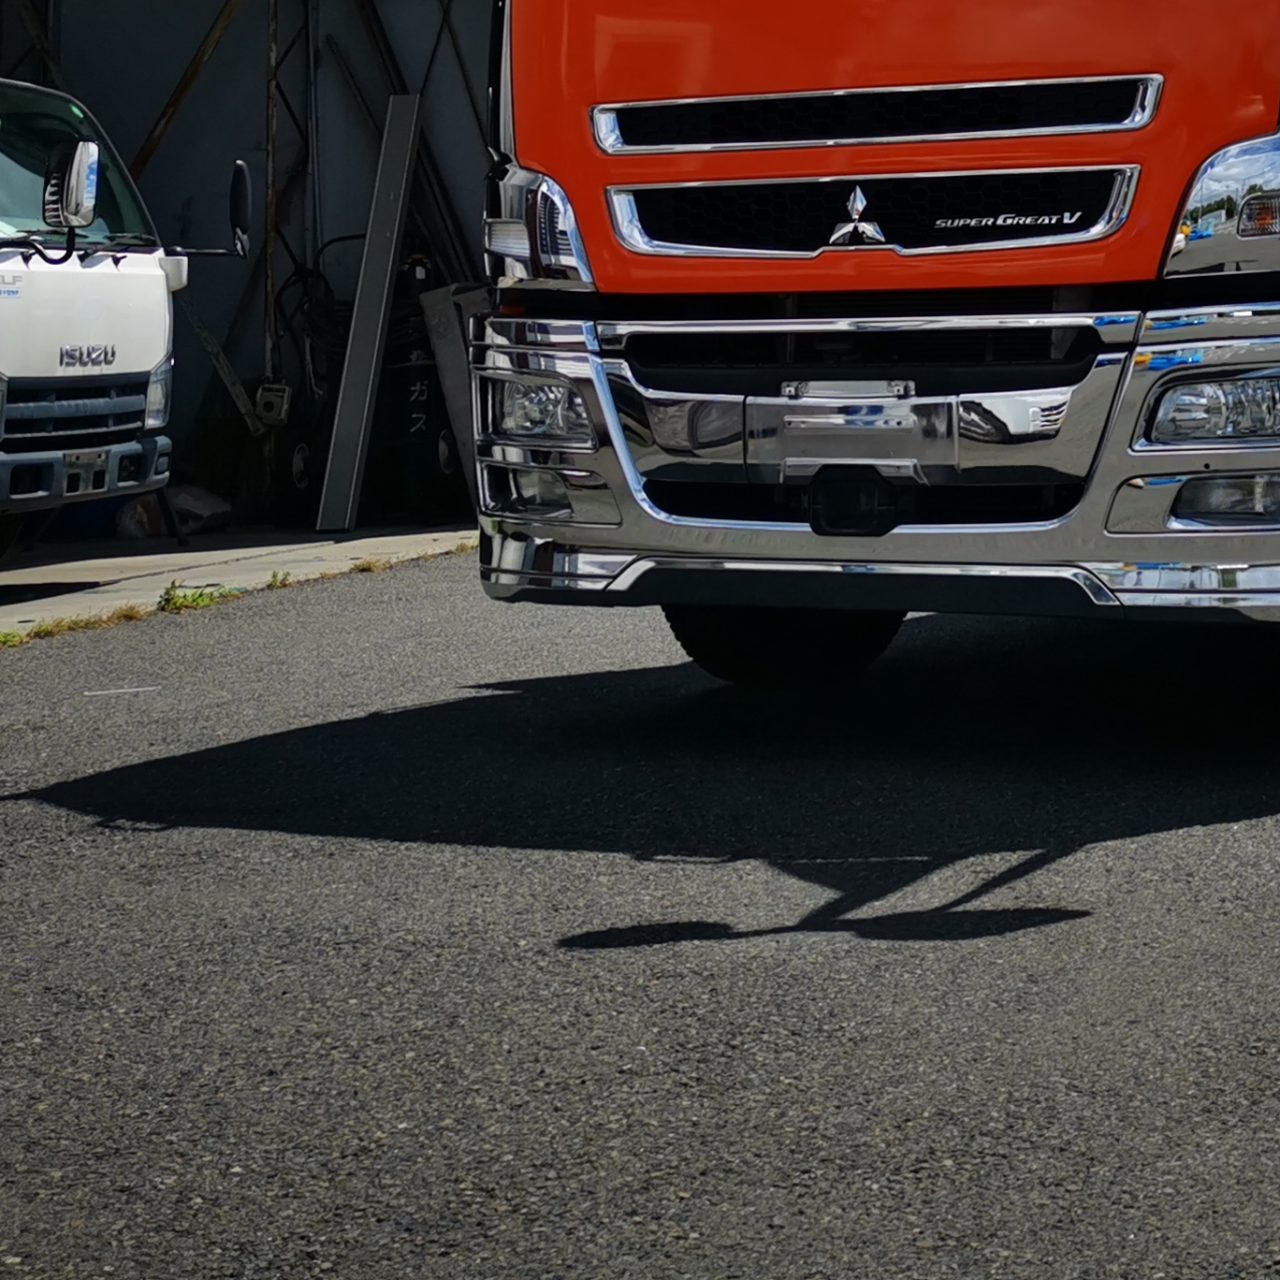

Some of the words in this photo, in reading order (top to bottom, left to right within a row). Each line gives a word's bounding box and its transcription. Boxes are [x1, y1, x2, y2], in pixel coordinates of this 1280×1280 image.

[934, 218, 994, 228] SUPER
[1062, 211, 1082, 224] V
[59, 344, 116, 367] ISUZU
